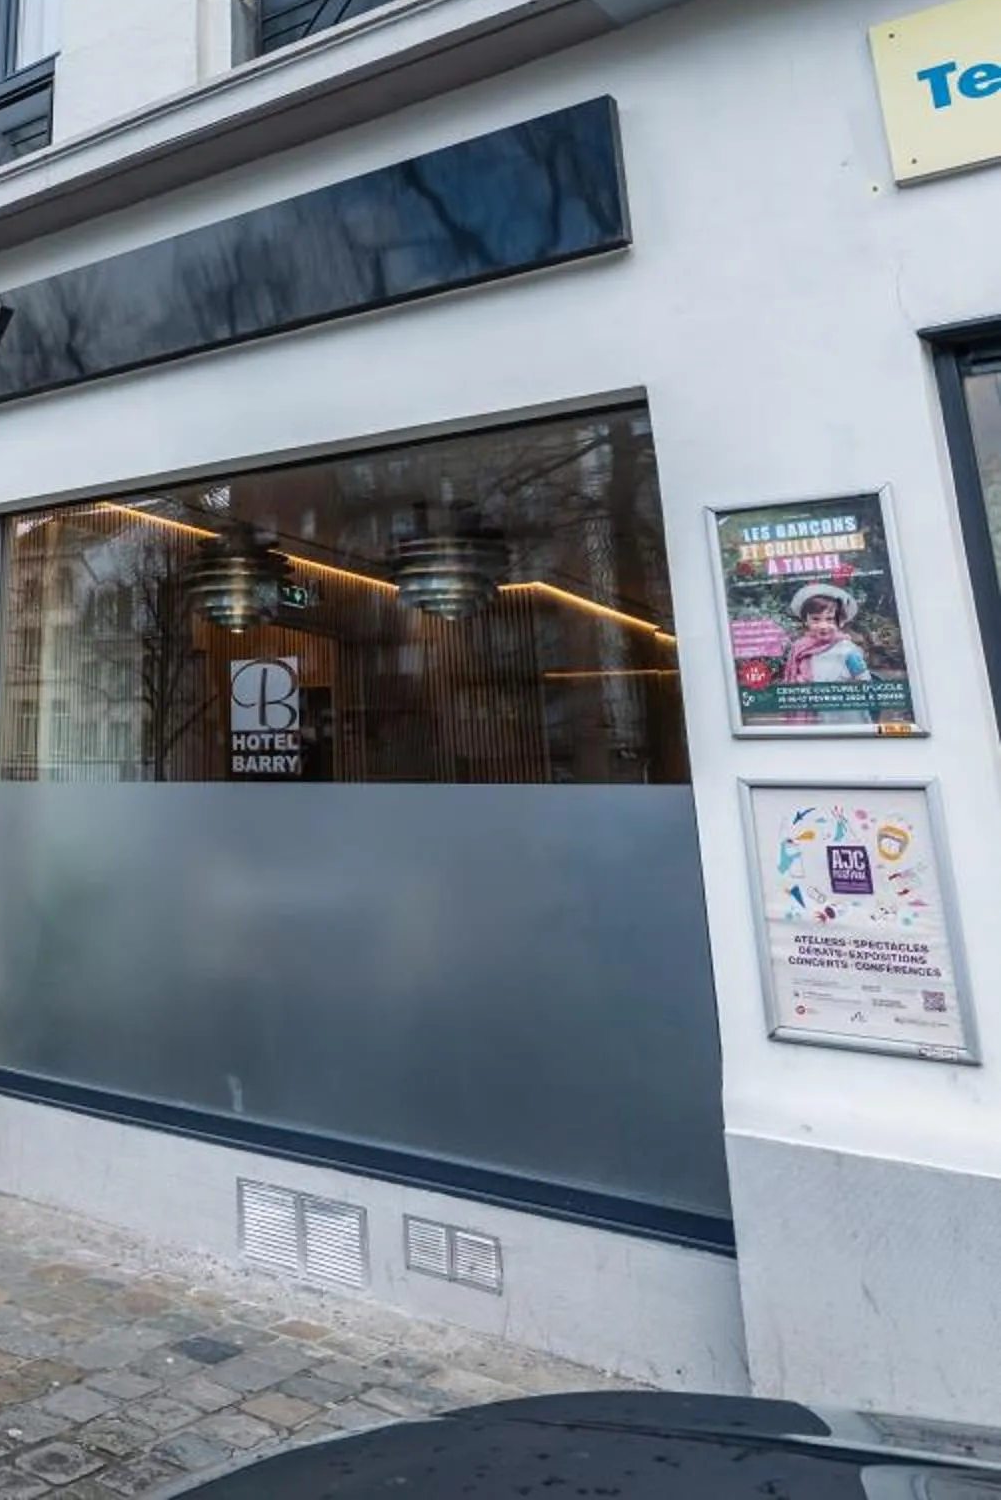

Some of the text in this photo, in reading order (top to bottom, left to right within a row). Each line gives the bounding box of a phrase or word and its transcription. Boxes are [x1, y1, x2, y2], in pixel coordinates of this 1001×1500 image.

[916, 61, 1001, 109] Te
[742, 525, 770, 542] LES
[740, 544, 760, 560] ET
[232, 733, 298, 751] HOTEL
[232, 755, 299, 773] BARRY
[794, 935, 930, 953] ATELIERS SPECTACLES
[788, 957, 849, 969] CONCERTS
[848, 950, 927, 965] EXPOSITIONS
